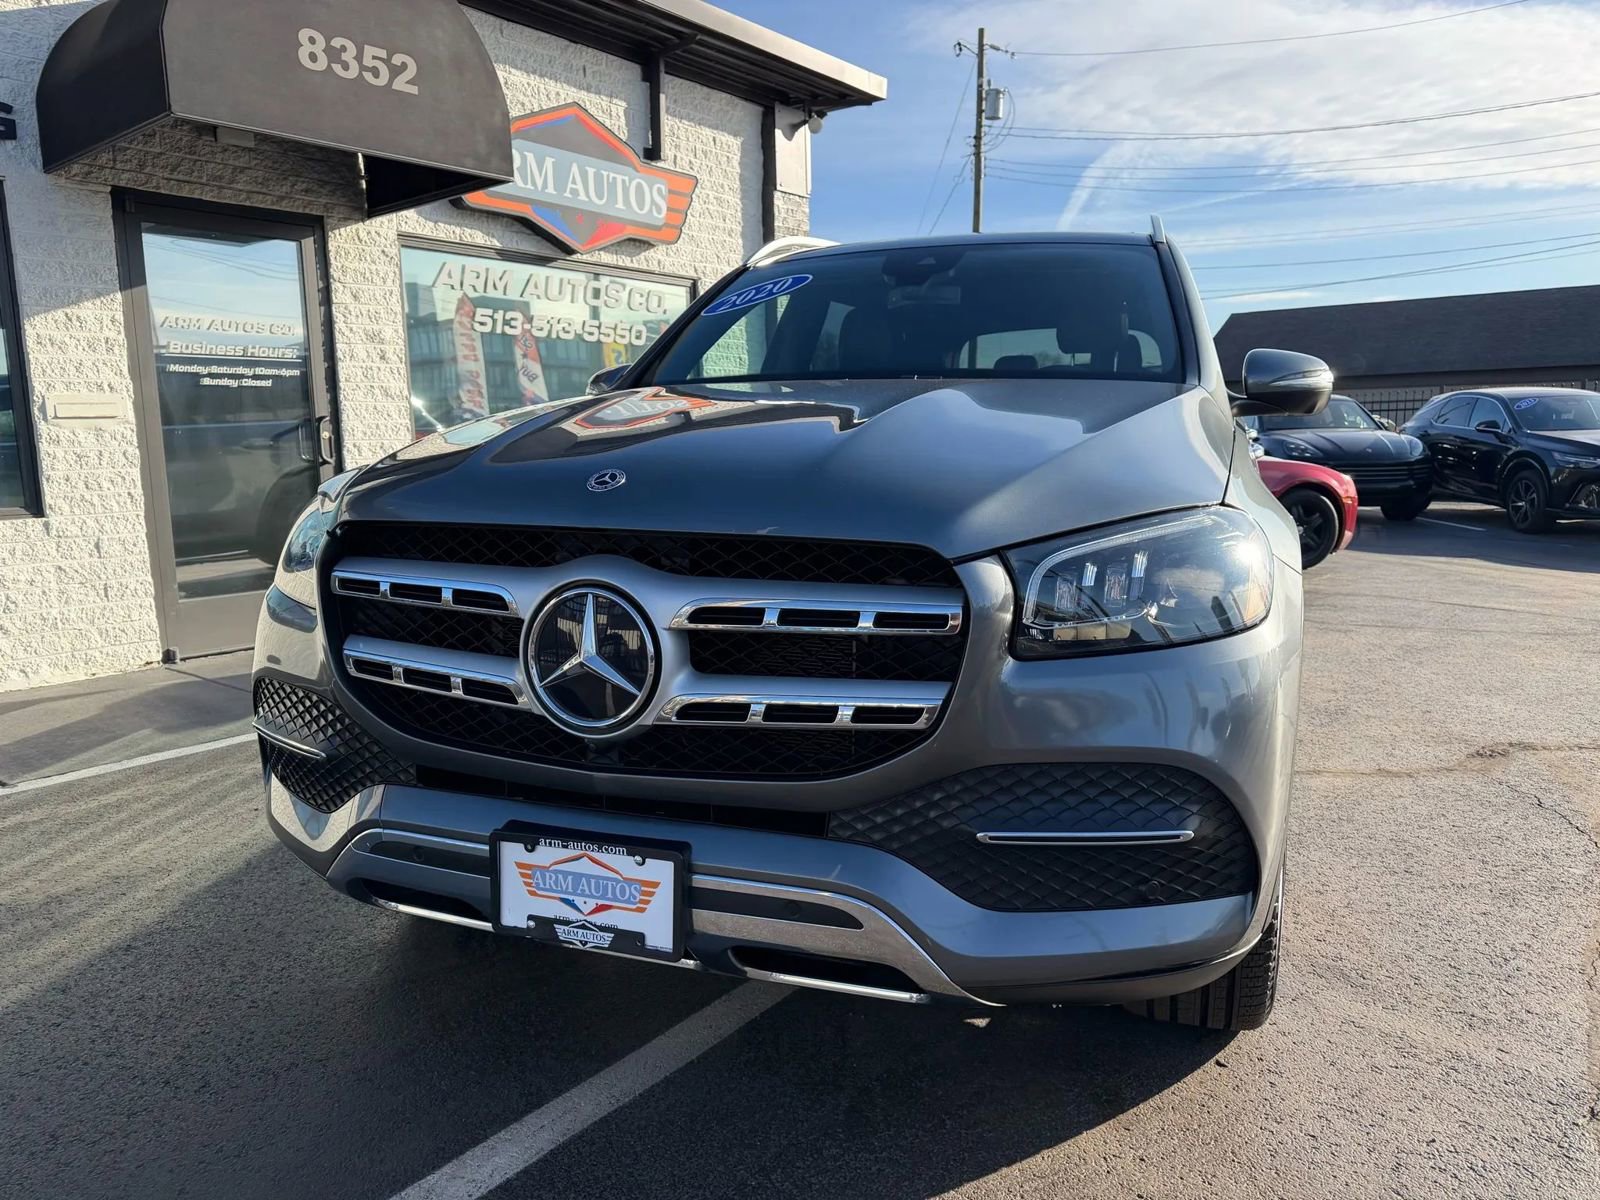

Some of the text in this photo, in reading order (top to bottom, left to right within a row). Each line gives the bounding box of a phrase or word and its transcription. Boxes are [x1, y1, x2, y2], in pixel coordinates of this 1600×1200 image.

[297, 28, 419, 95] 8352
[512, 149, 667, 218] RM AUTOS
[432, 262, 514, 296] ARM
[520, 272, 628, 309] AUTOS
[716, 278, 793, 311] 2020
[160, 316, 202, 329] ARM
[206, 319, 265, 334] AUTOS
[472, 308, 648, 346] 513-513-5550
[168, 340, 298, 359] Business Hours:
[201, 378, 272, 387] Sunday Closed
[539, 838, 627, 856] arm-autos.com
[533, 871, 641, 902] ARM AUTOS
[561, 928, 606, 942] ARM AUTOS
